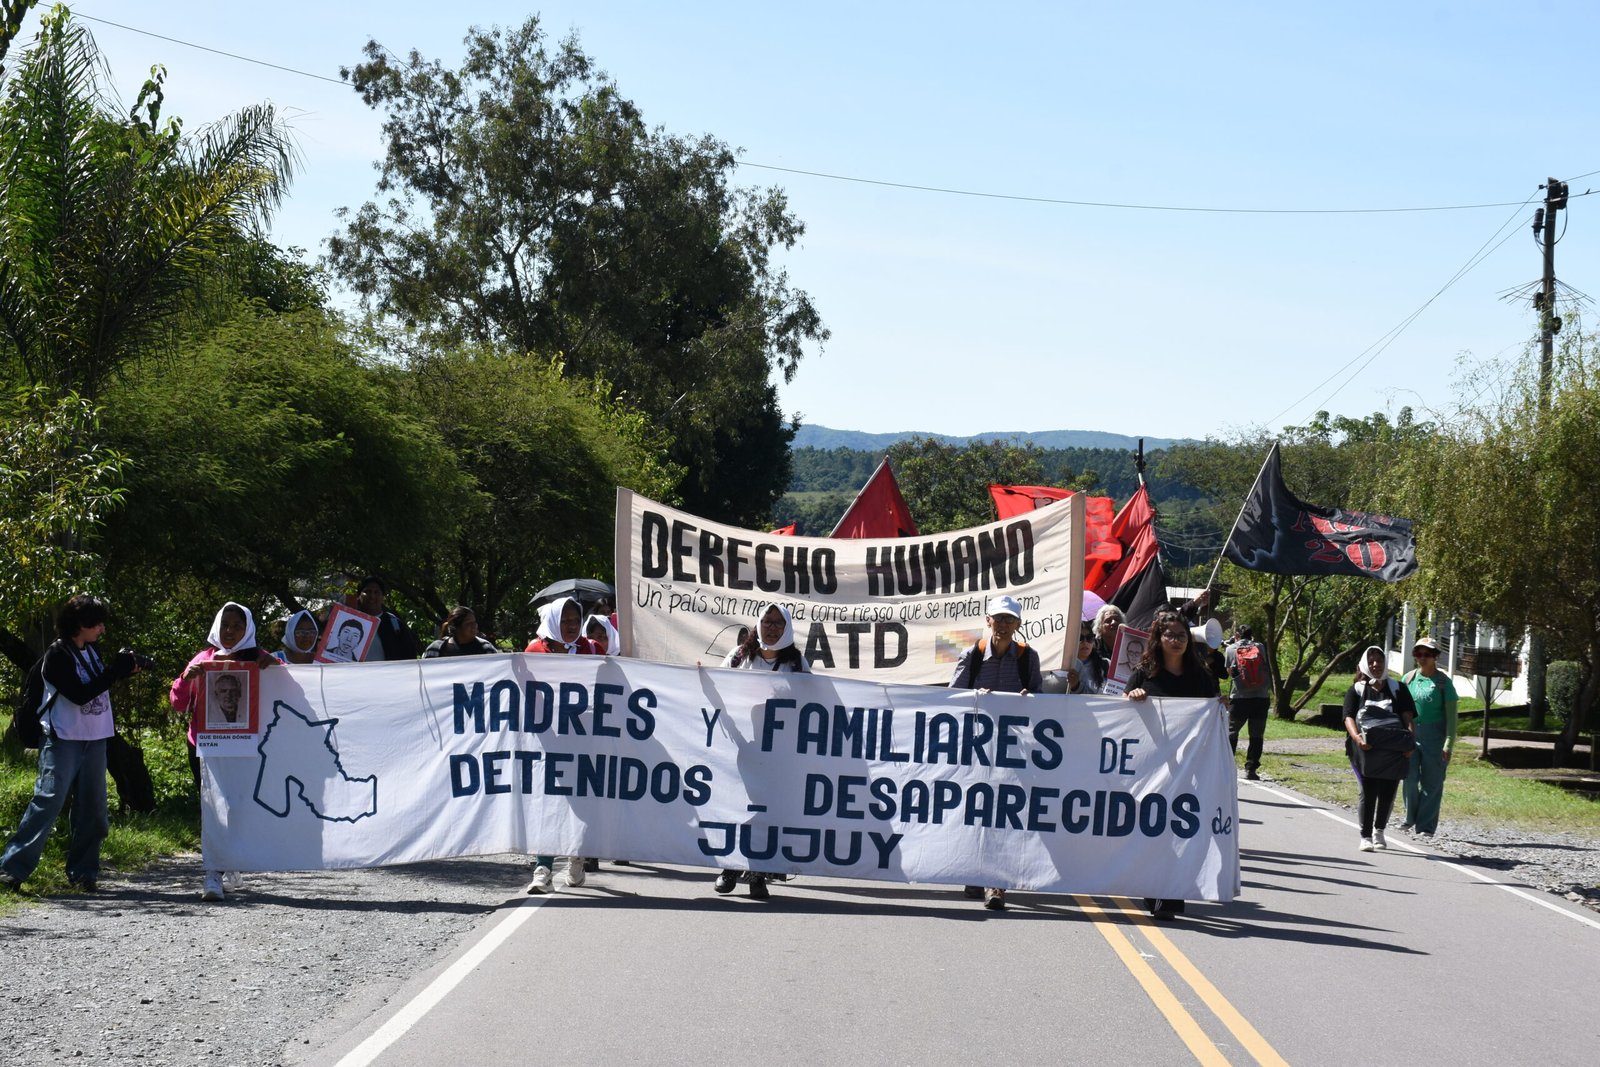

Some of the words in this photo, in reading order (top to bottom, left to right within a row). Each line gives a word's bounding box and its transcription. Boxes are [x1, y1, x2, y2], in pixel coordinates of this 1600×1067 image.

[641, 510, 837, 595] DERECHO
[866, 519, 1034, 596] HUMANO
[637, 581, 662, 609] Un
[669, 588, 707, 614] país
[711, 595, 737, 616] sin
[811, 603, 847, 622] corre
[852, 604, 894, 623] riesgo
[900, 601, 922, 625] que
[924, 601, 940, 620] se
[943, 596, 981, 622] repita
[453, 680, 657, 741] MADRES
[701, 708, 721, 748] Y
[761, 698, 1065, 771] FAMILIARES
[1099, 736, 1140, 776] DE
[450, 750, 713, 806] DETENIDOS
[803, 773, 1201, 839] DESAPARECIDOS
[1211, 806, 1232, 836] de
[697, 820, 904, 870] JUJUY
